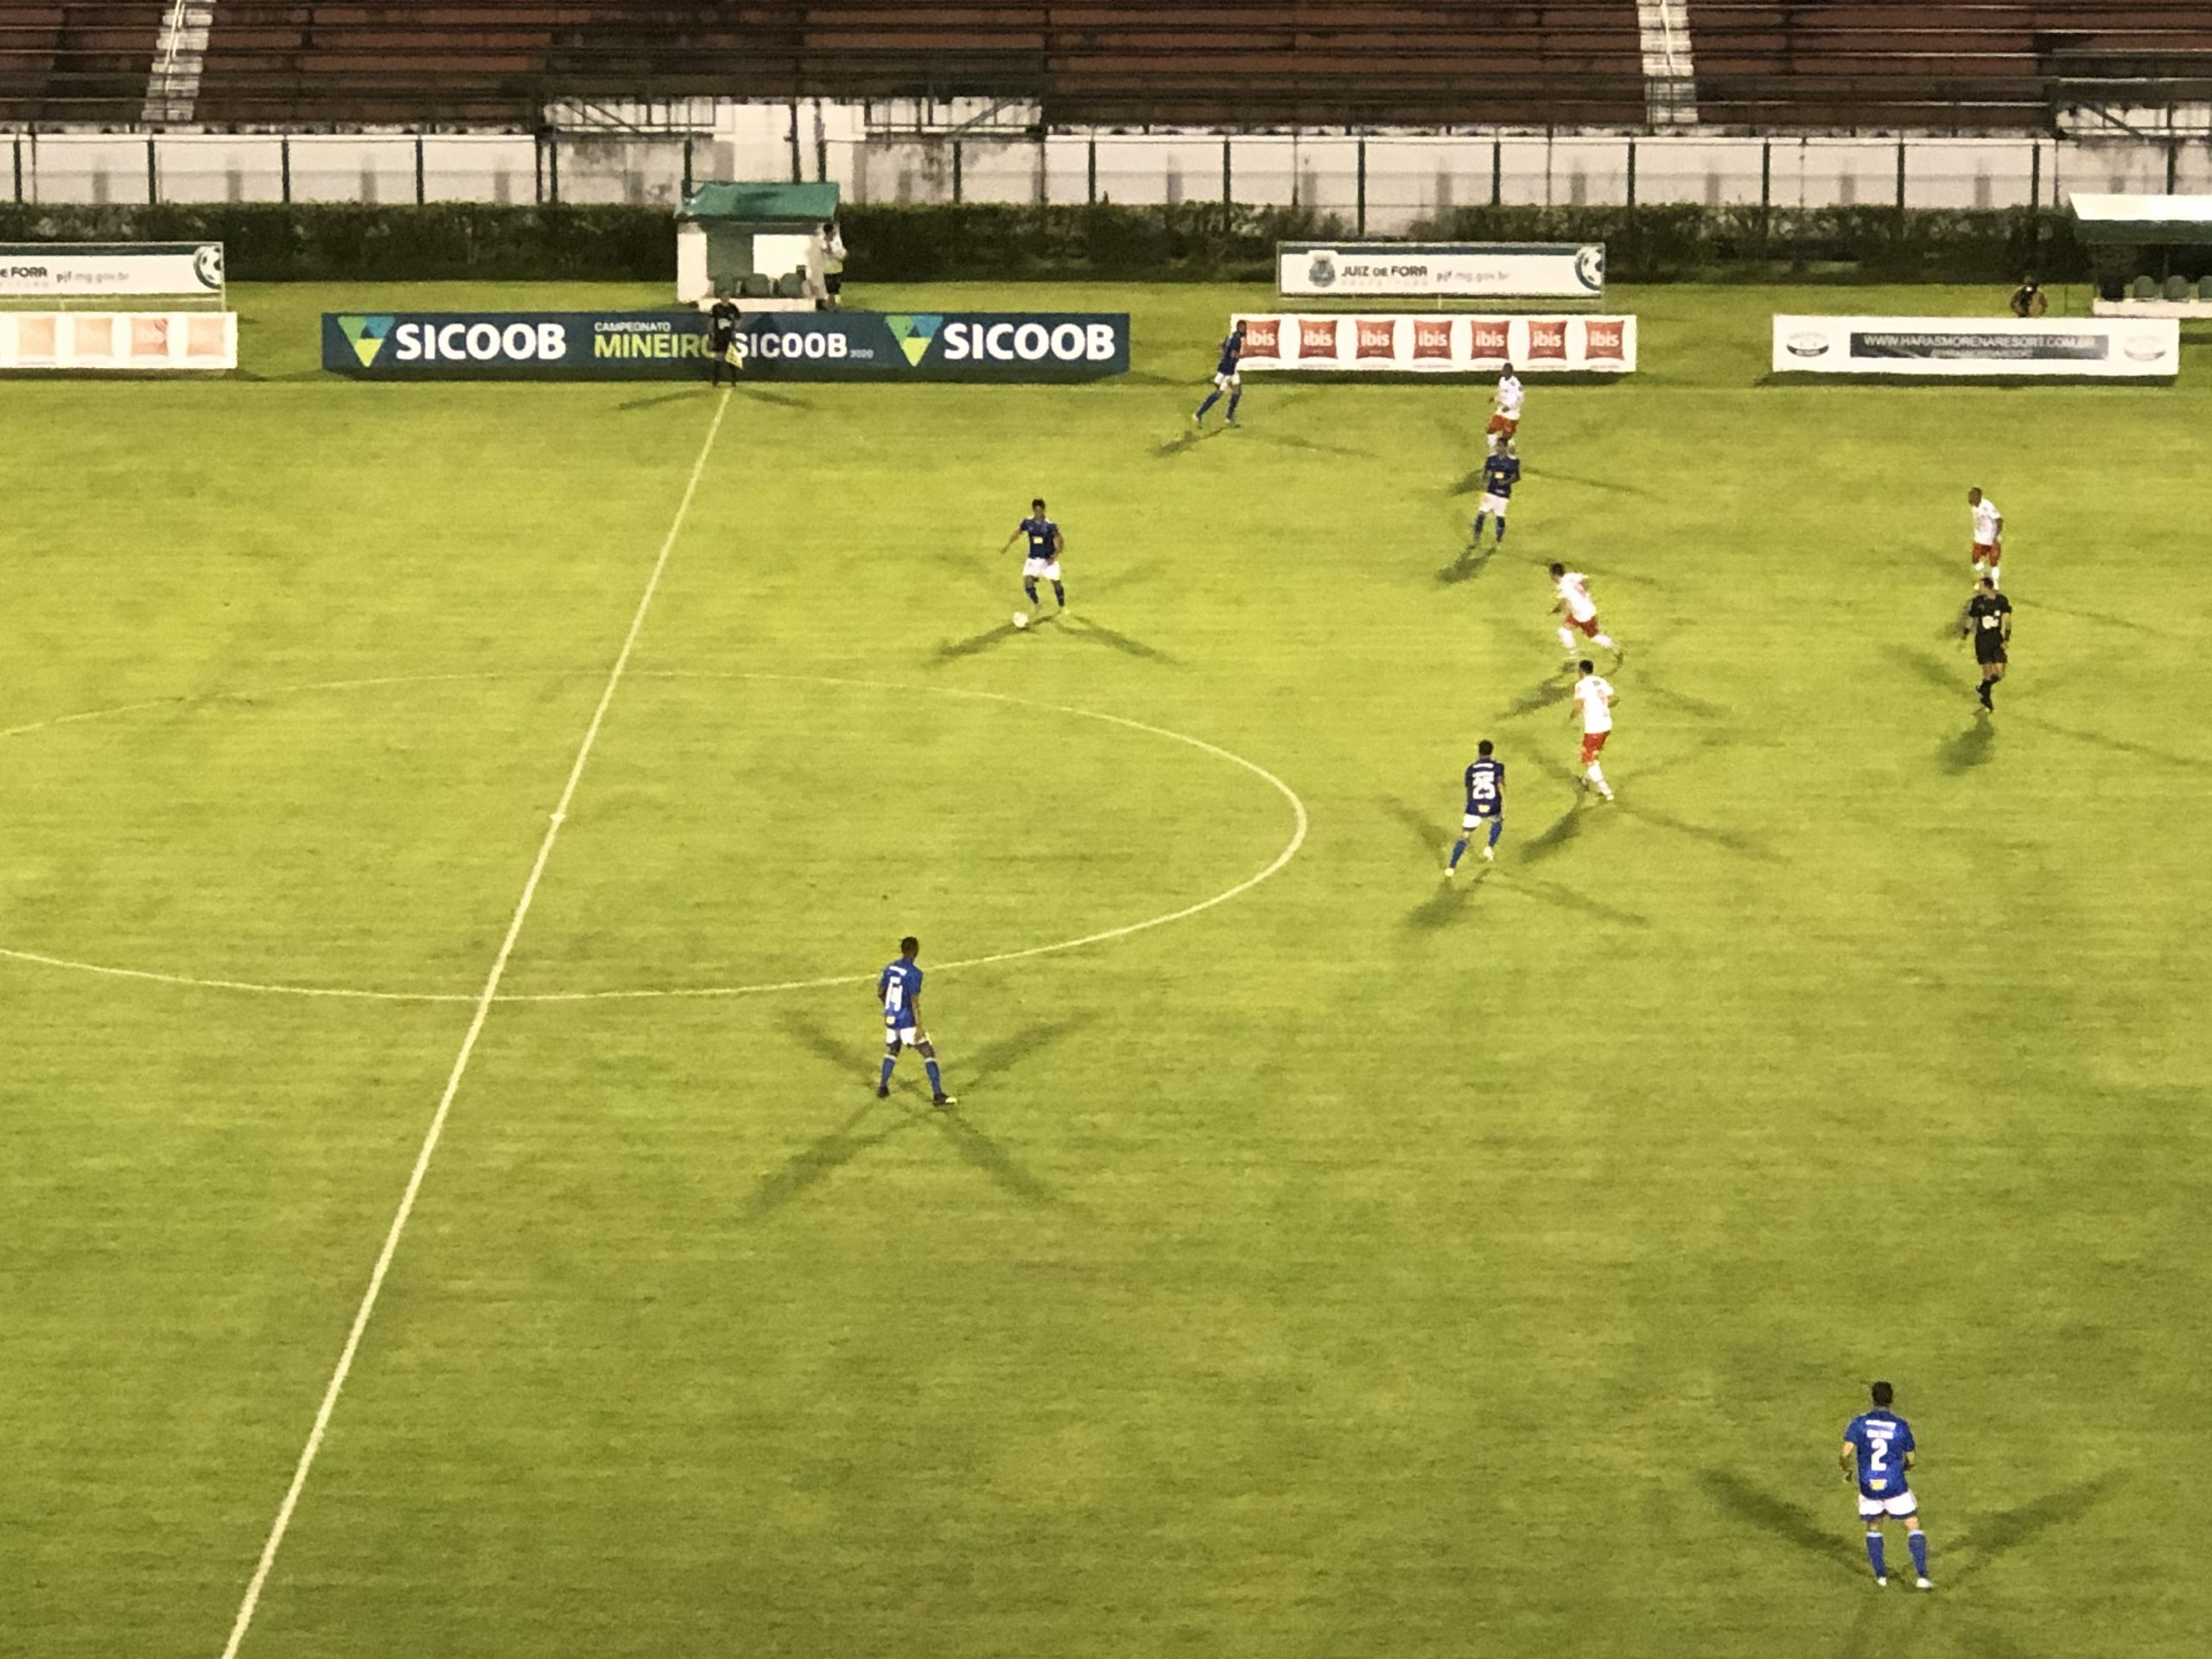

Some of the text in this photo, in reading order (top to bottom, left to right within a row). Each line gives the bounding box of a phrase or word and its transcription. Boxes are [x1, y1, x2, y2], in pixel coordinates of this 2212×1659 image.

[10, 266, 48, 277] FORA
[1341, 266, 1369, 276] JUIZ
[1391, 265, 1427, 276] FORA
[594, 321, 671, 332] CAMPEONATO
[395, 322, 566, 360] SICOOB
[734, 332, 848, 359] SICOOB
[944, 322, 1116, 360] SICOOB
[1247, 329, 1275, 346] ibis
[1303, 329, 1333, 346] ibis
[1360, 329, 1389, 346] ibis
[1418, 329, 1447, 346] ibis
[1476, 329, 1505, 346] ibis
[1533, 329, 1562, 346] ibis
[1590, 329, 1620, 346] ibis
[1871, 1438, 1888, 1471] 2
